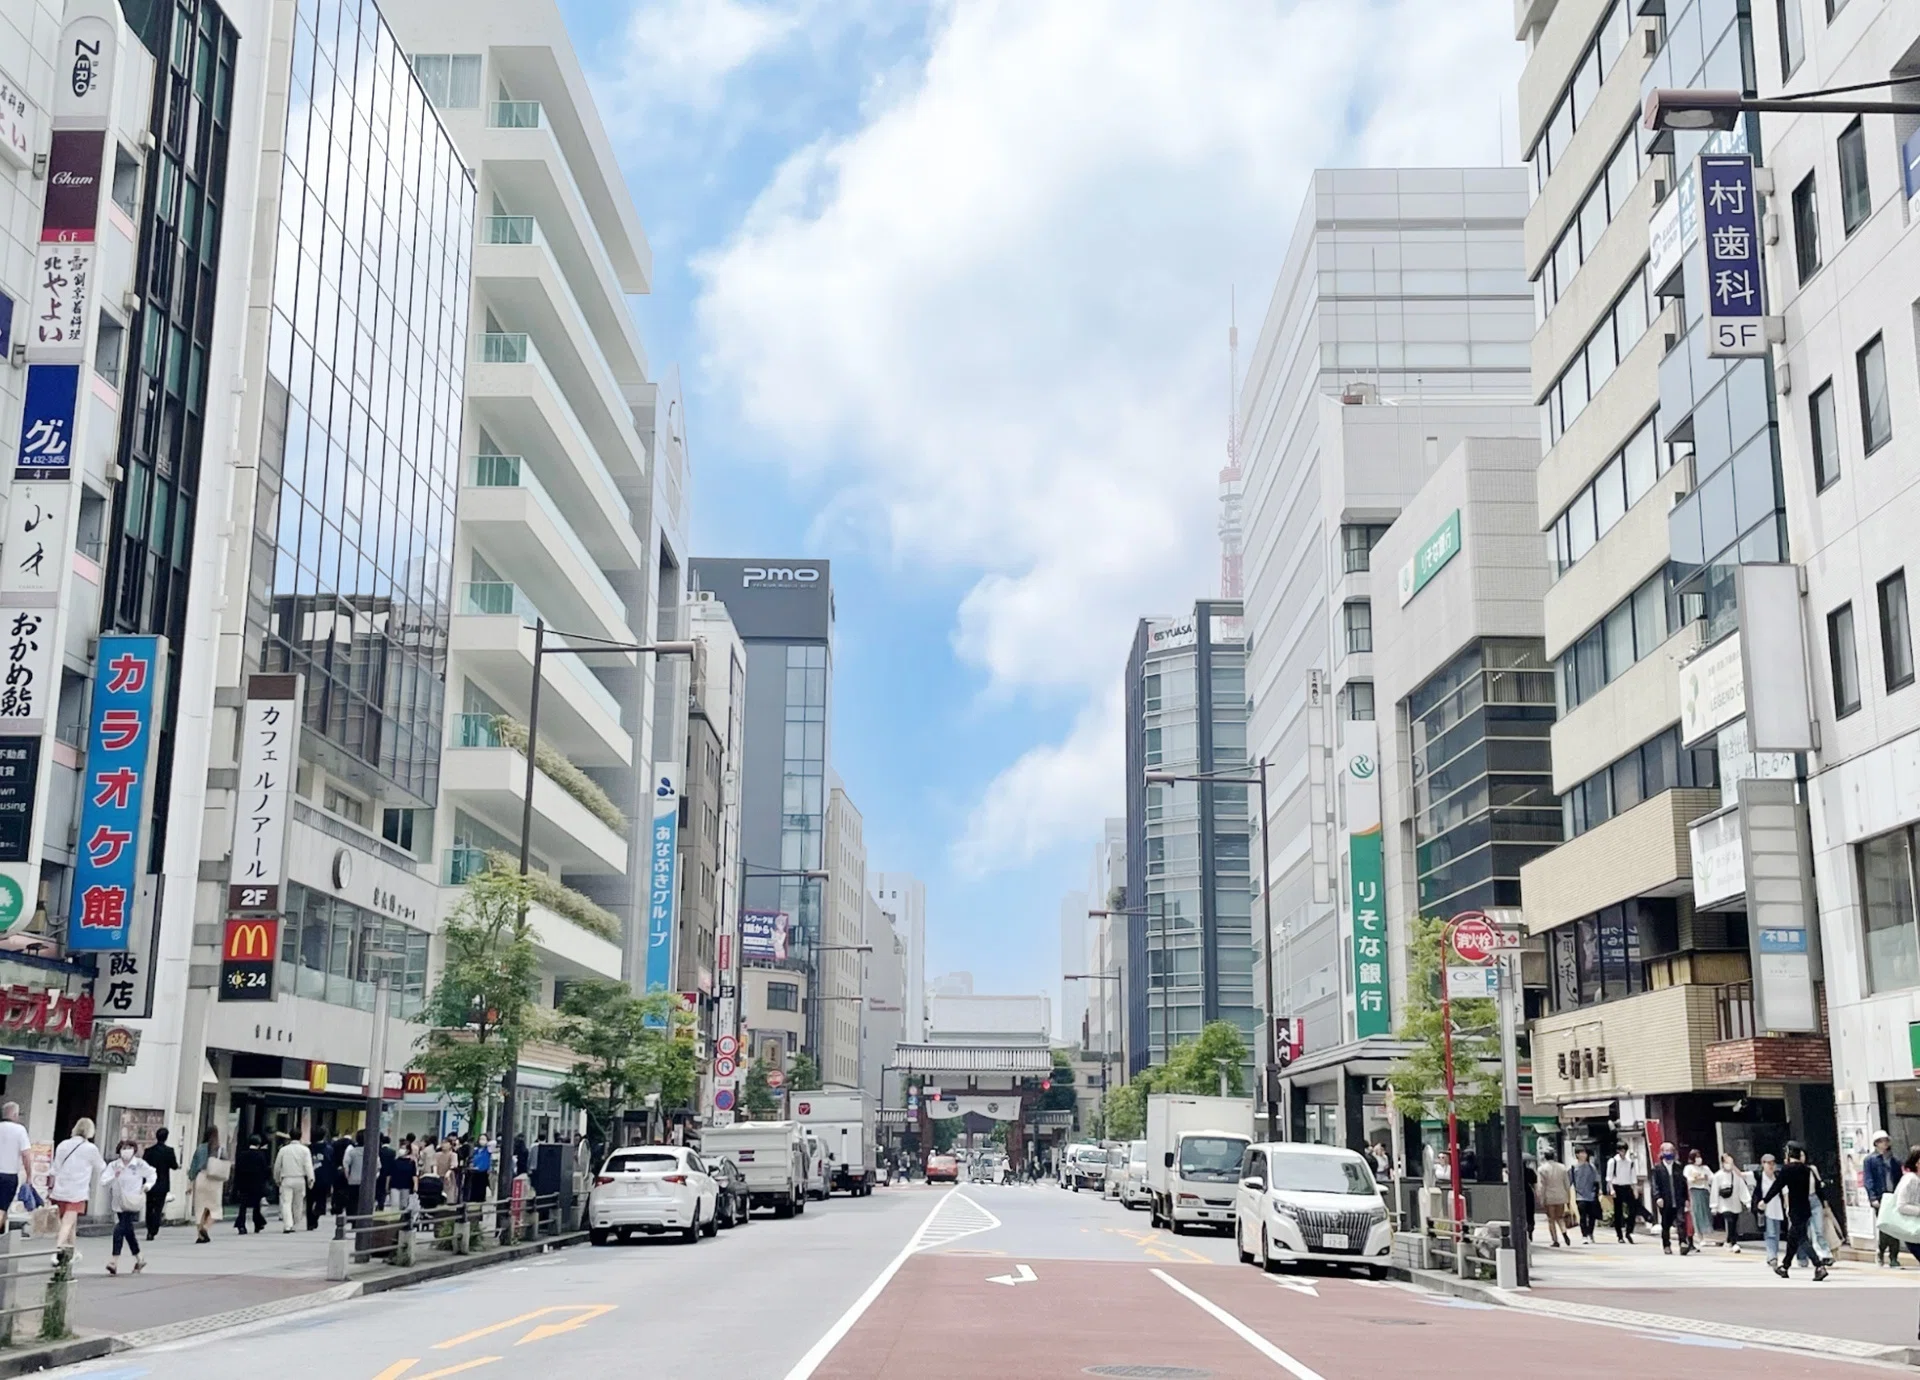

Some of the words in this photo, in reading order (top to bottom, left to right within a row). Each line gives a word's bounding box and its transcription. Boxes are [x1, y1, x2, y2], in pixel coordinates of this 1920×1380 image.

[75, 39, 100, 95] ZERO
[52, 171, 94, 185] Cham
[1719, 324, 1758, 348] 5F
[80, 653, 148, 930] カラオケ館
[245, 705, 280, 878] カフェルノアール
[240, 888, 268, 906] 2F
[650, 826, 671, 948] あなぶきグループ
[1357, 880, 1383, 1013] りそな銀行
[1456, 932, 1493, 949] 消火栓
[103, 952, 138, 1011] 飯店
[247, 973, 267, 988] 24
